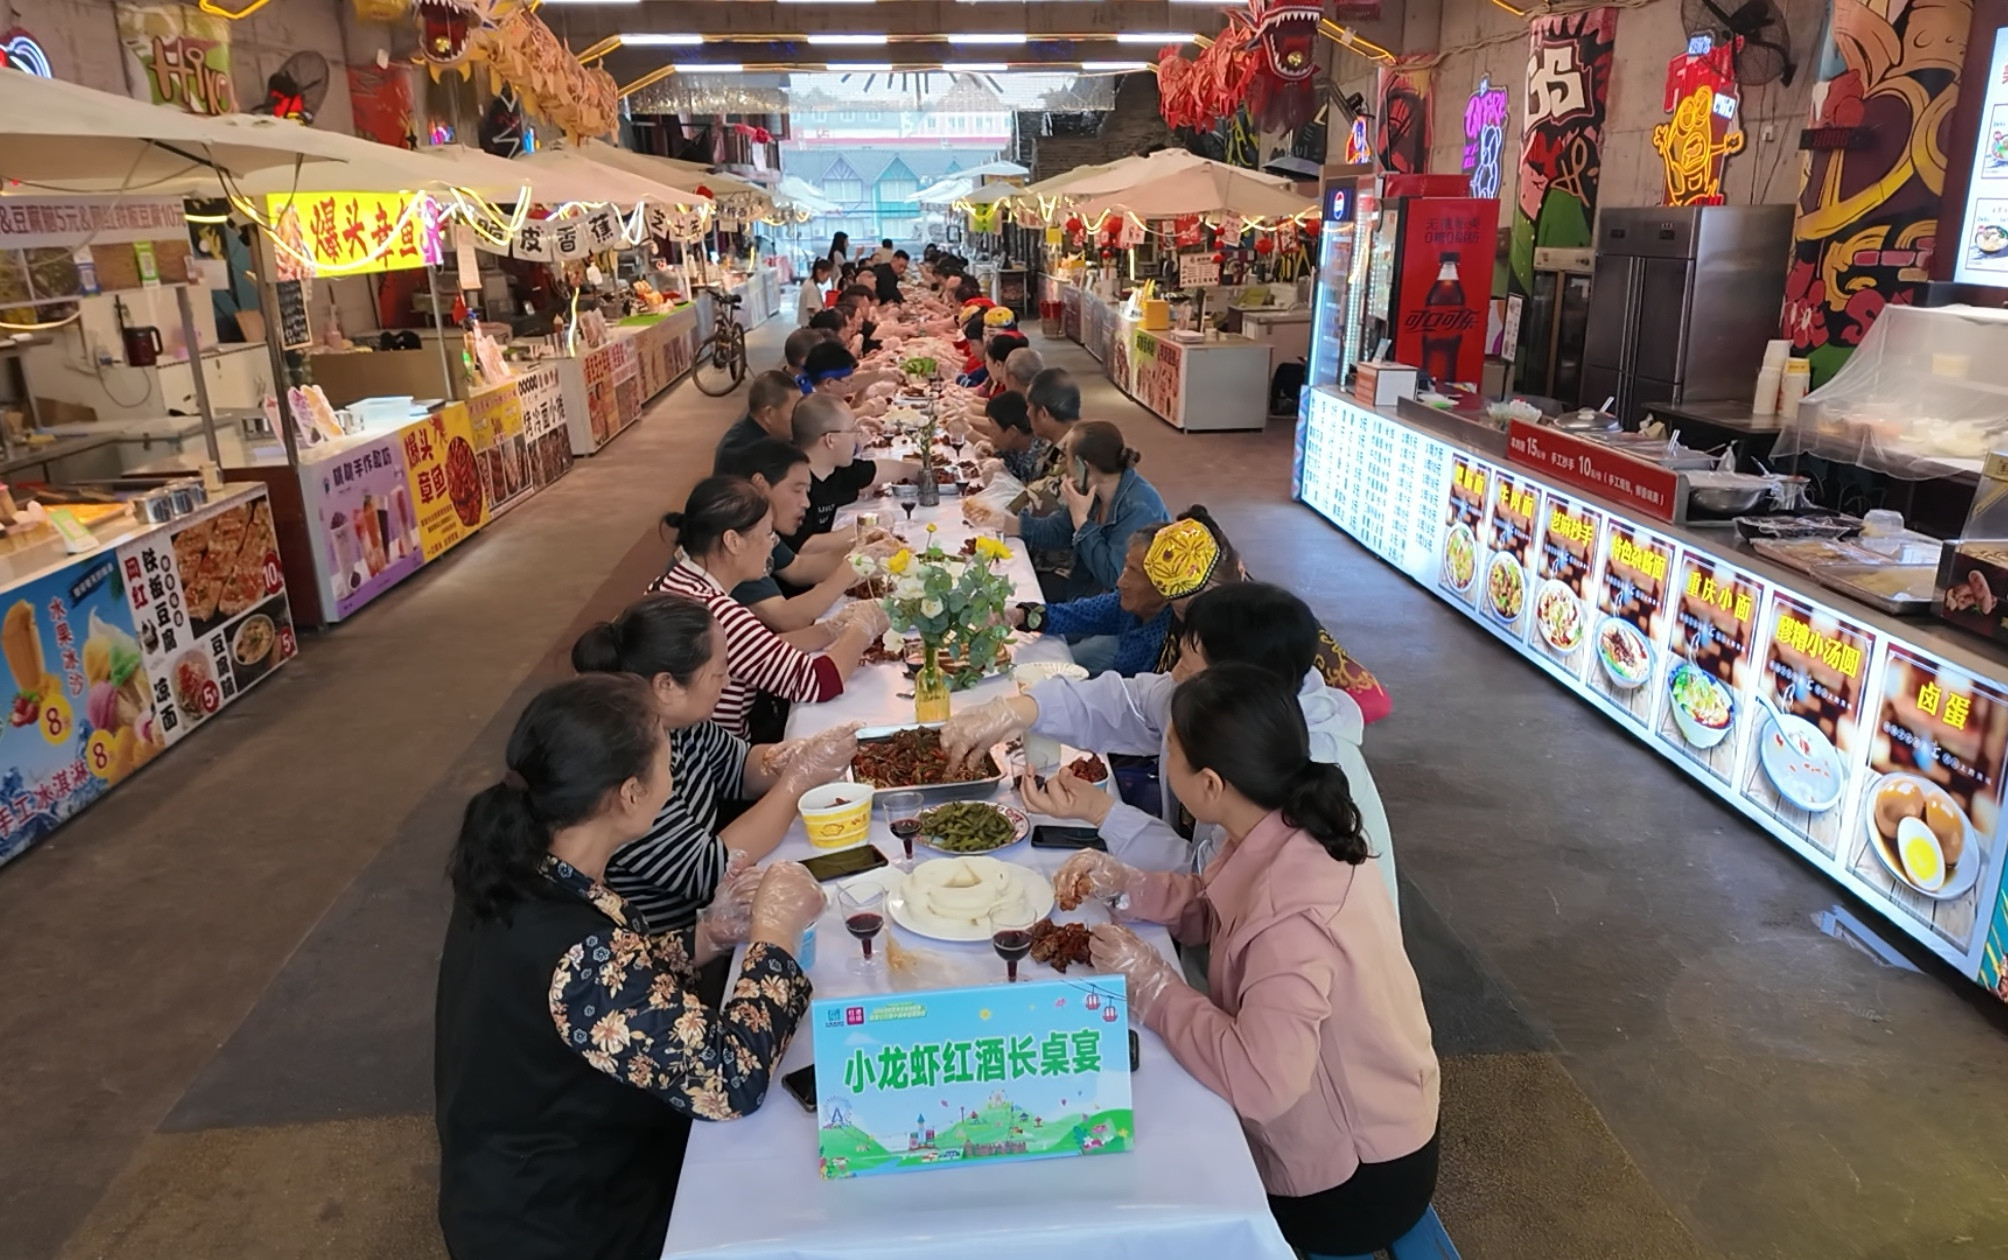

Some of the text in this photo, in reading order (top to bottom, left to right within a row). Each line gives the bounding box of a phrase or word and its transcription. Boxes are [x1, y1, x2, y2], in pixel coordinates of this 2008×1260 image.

[311, 196, 418, 268] 爆头章鱼
[1404, 308, 1482, 333] 可口可乐
[1499, 483, 1534, 519] 牛肉面
[1686, 571, 1752, 622] 重庆小面
[48, 597, 84, 697] 水果冰沙
[1776, 613, 1861, 679] 醪糟小汤圆
[1916, 681, 1971, 730] 卤蛋
[844, 1029, 1101, 1094] 小龙虾红酒长桌宴
